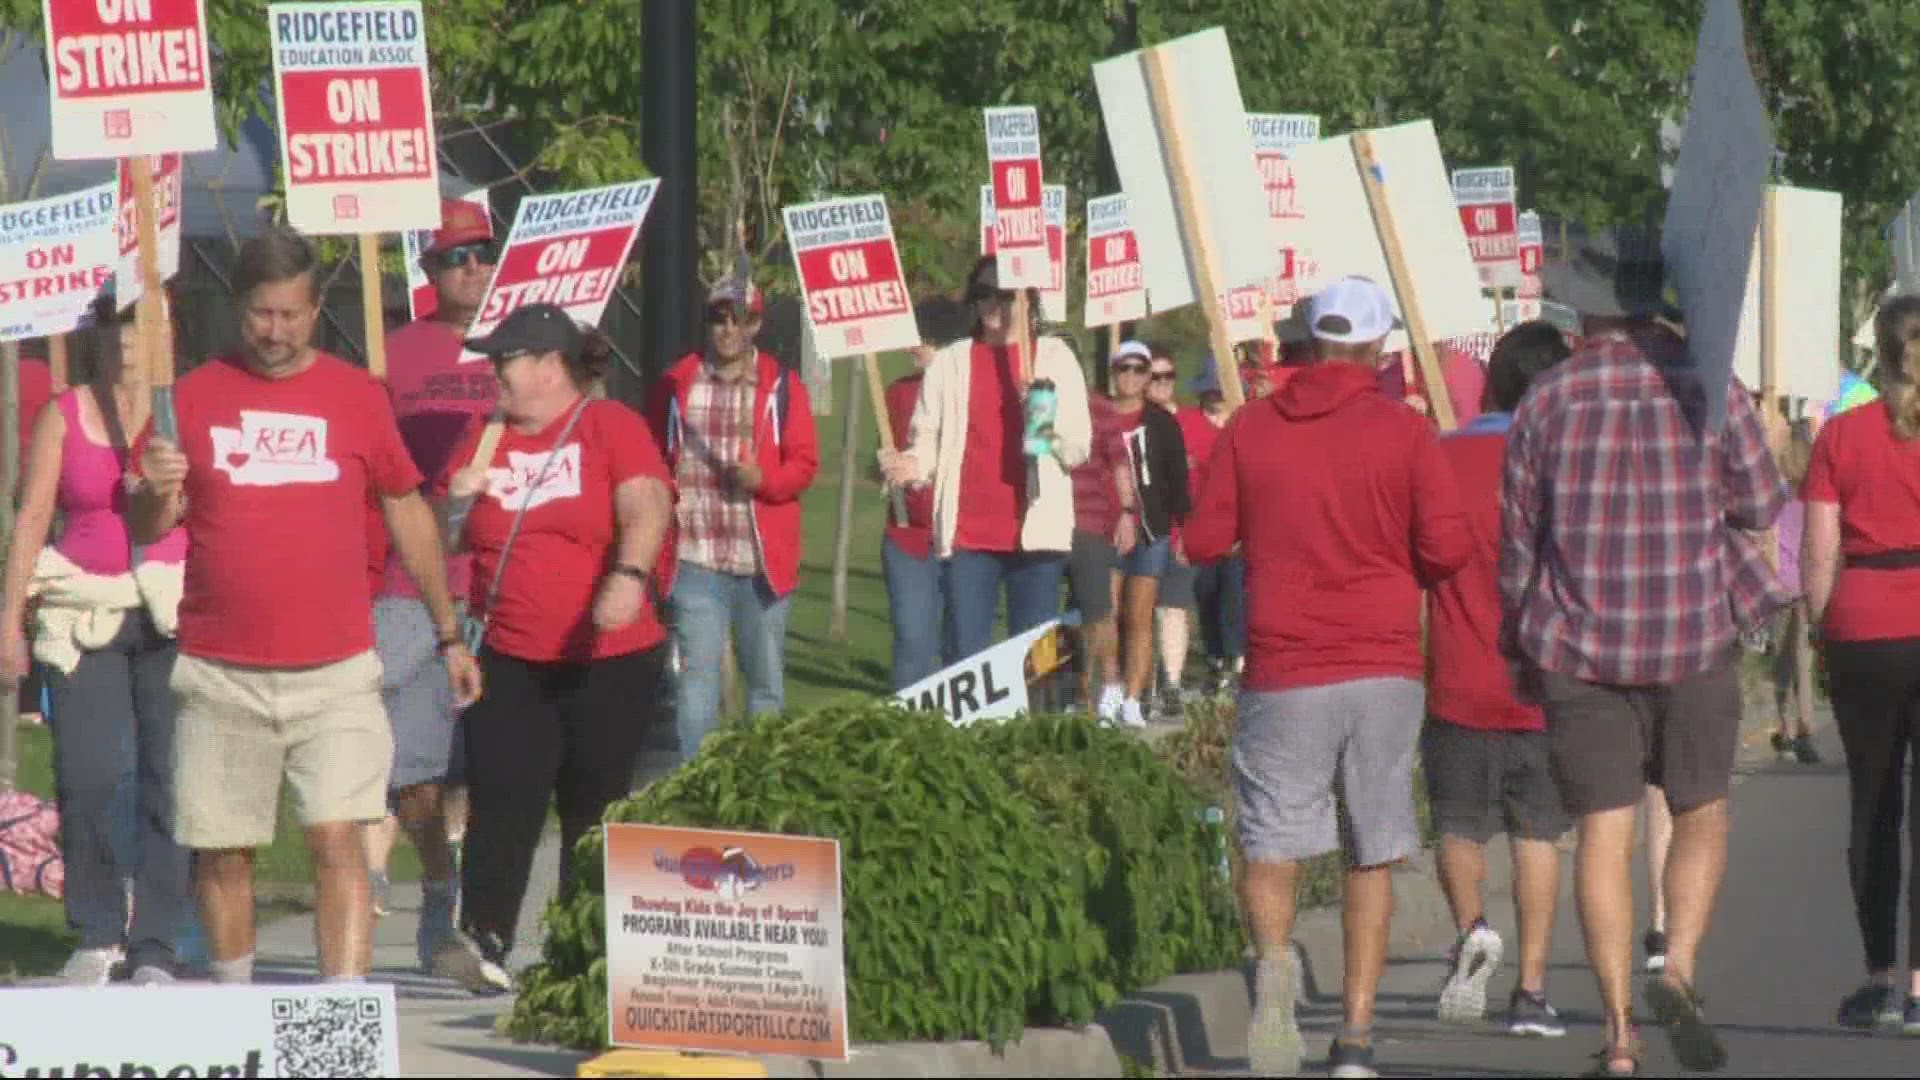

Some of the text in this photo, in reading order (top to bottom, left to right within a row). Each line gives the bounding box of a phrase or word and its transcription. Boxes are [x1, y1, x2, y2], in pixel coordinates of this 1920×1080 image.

[277, 10, 417, 43] RIDGEFIELD
[57, 27, 200, 91] STRIKE!
[280, 47, 414, 66] EDUCATION ASSOC
[327, 77, 381, 124] ON
[290, 127, 428, 178] STRIKE!
[1006, 166, 1027, 203] ON
[522, 184, 650, 225] RIDGEFIELD
[789, 201, 885, 232] RIDGEFIELD
[26, 244, 75, 270] ON
[536, 237, 591, 273] ON
[829, 248, 869, 282] ON
[1105, 237, 1127, 264] ON
[482, 265, 613, 321] STRIKE!
[809, 280, 906, 320] STRIKE!
[255, 427, 318, 459] REA
[623, 913, 691, 938] PROGRAMS
[695, 917, 761, 943] AVAILABLE
[764, 924, 797, 945] NEAR
[625, 1006, 833, 1043] QUICKSTARTSPORTSLLC.COM
